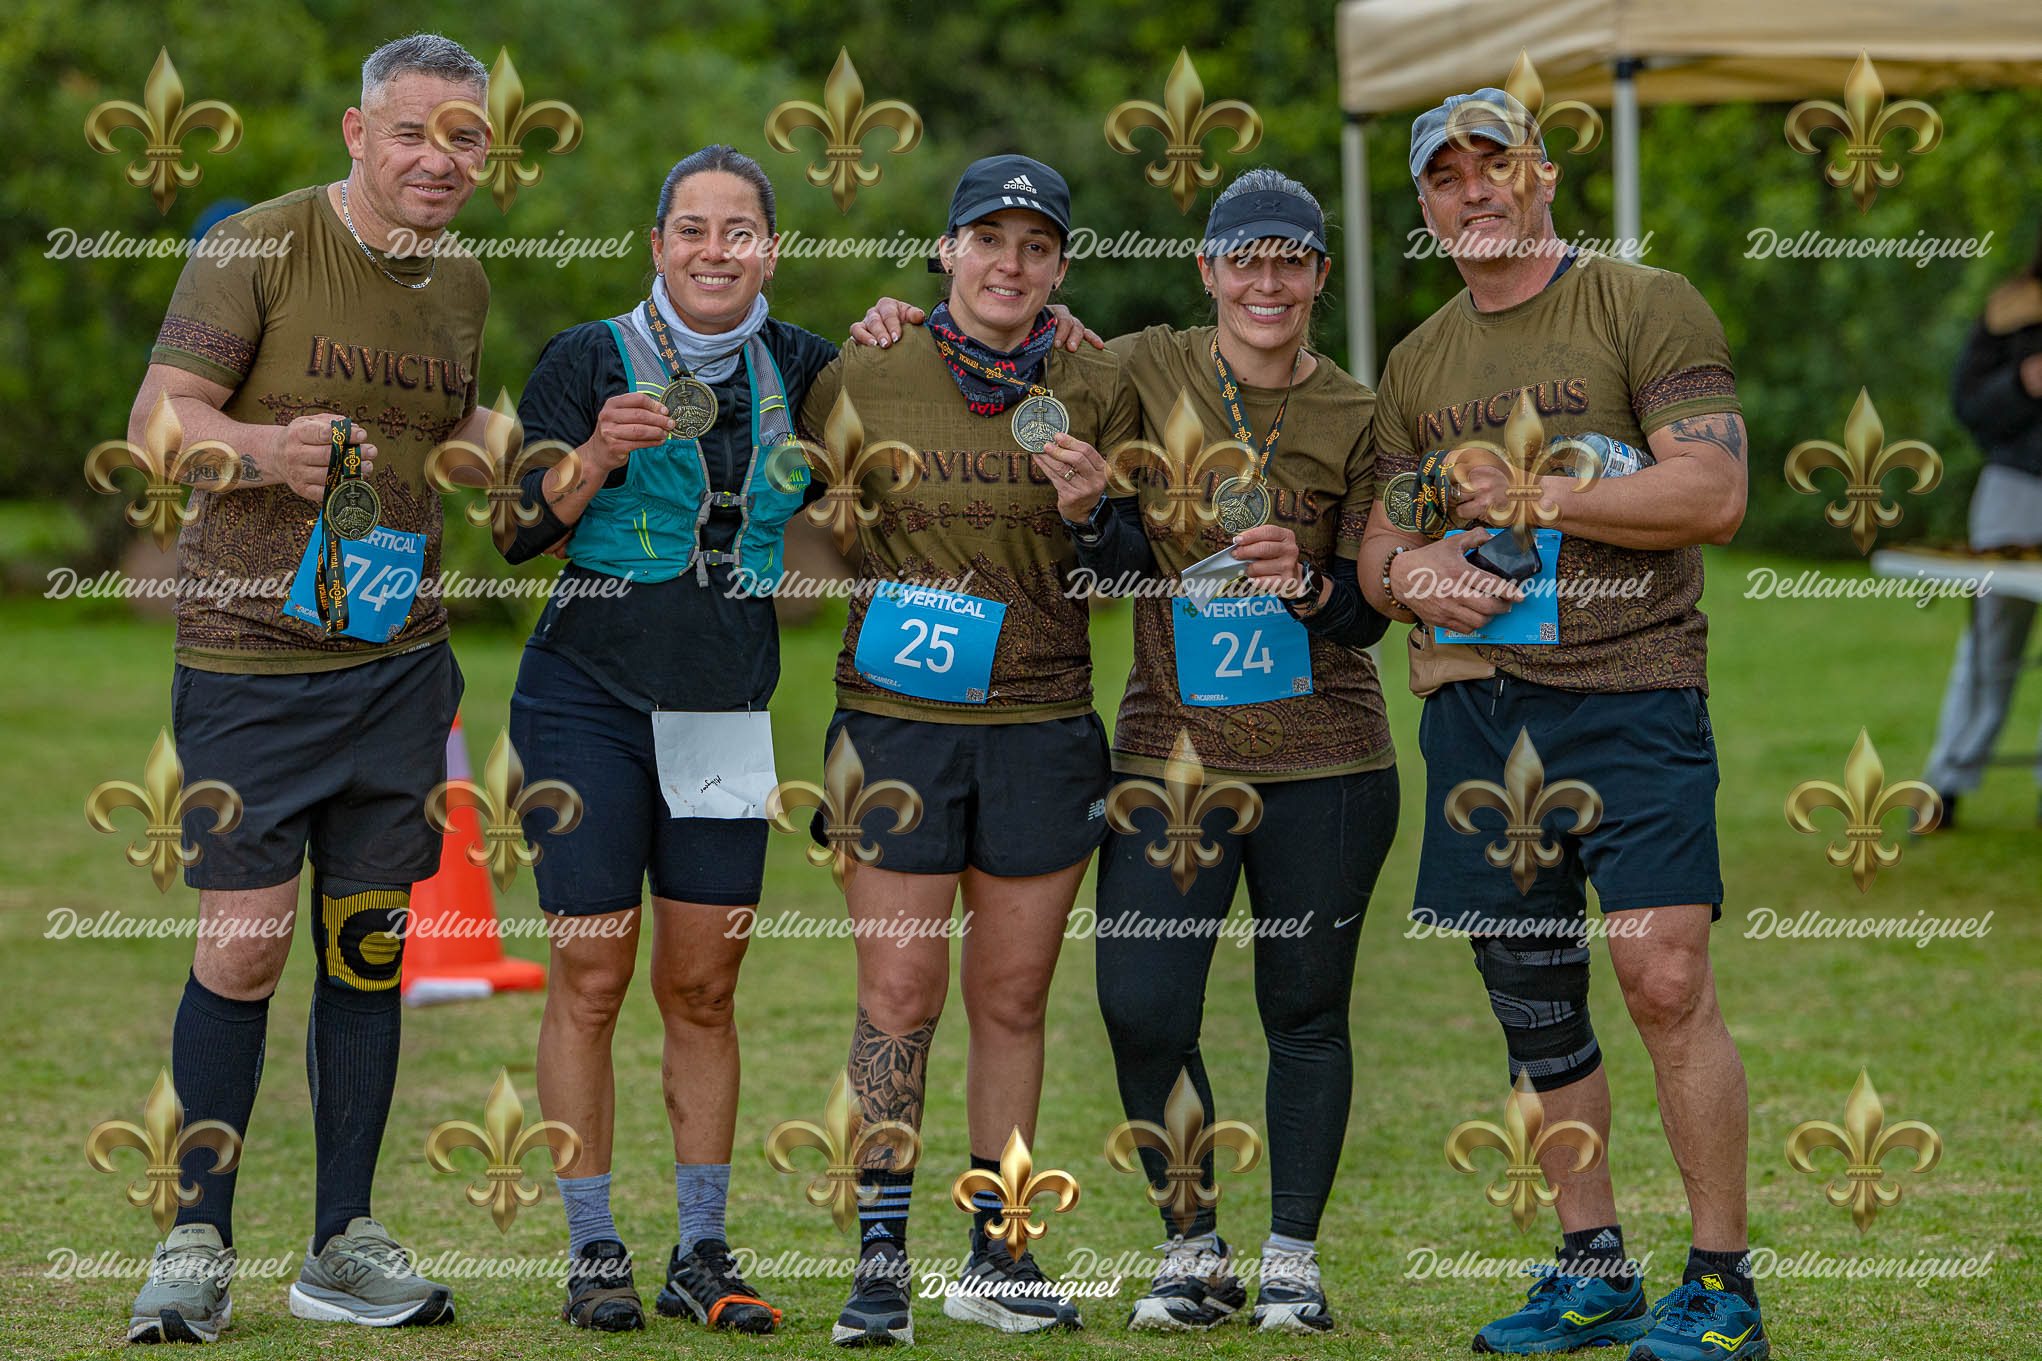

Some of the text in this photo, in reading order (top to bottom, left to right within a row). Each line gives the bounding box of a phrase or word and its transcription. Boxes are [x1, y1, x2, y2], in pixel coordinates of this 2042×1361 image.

[1003, 183, 1037, 194] adidas
[343, 553, 391, 612] 74
[903, 589, 986, 619] VERTICAL
[893, 618, 959, 674] 25
[1212, 630, 1274, 678] 24
